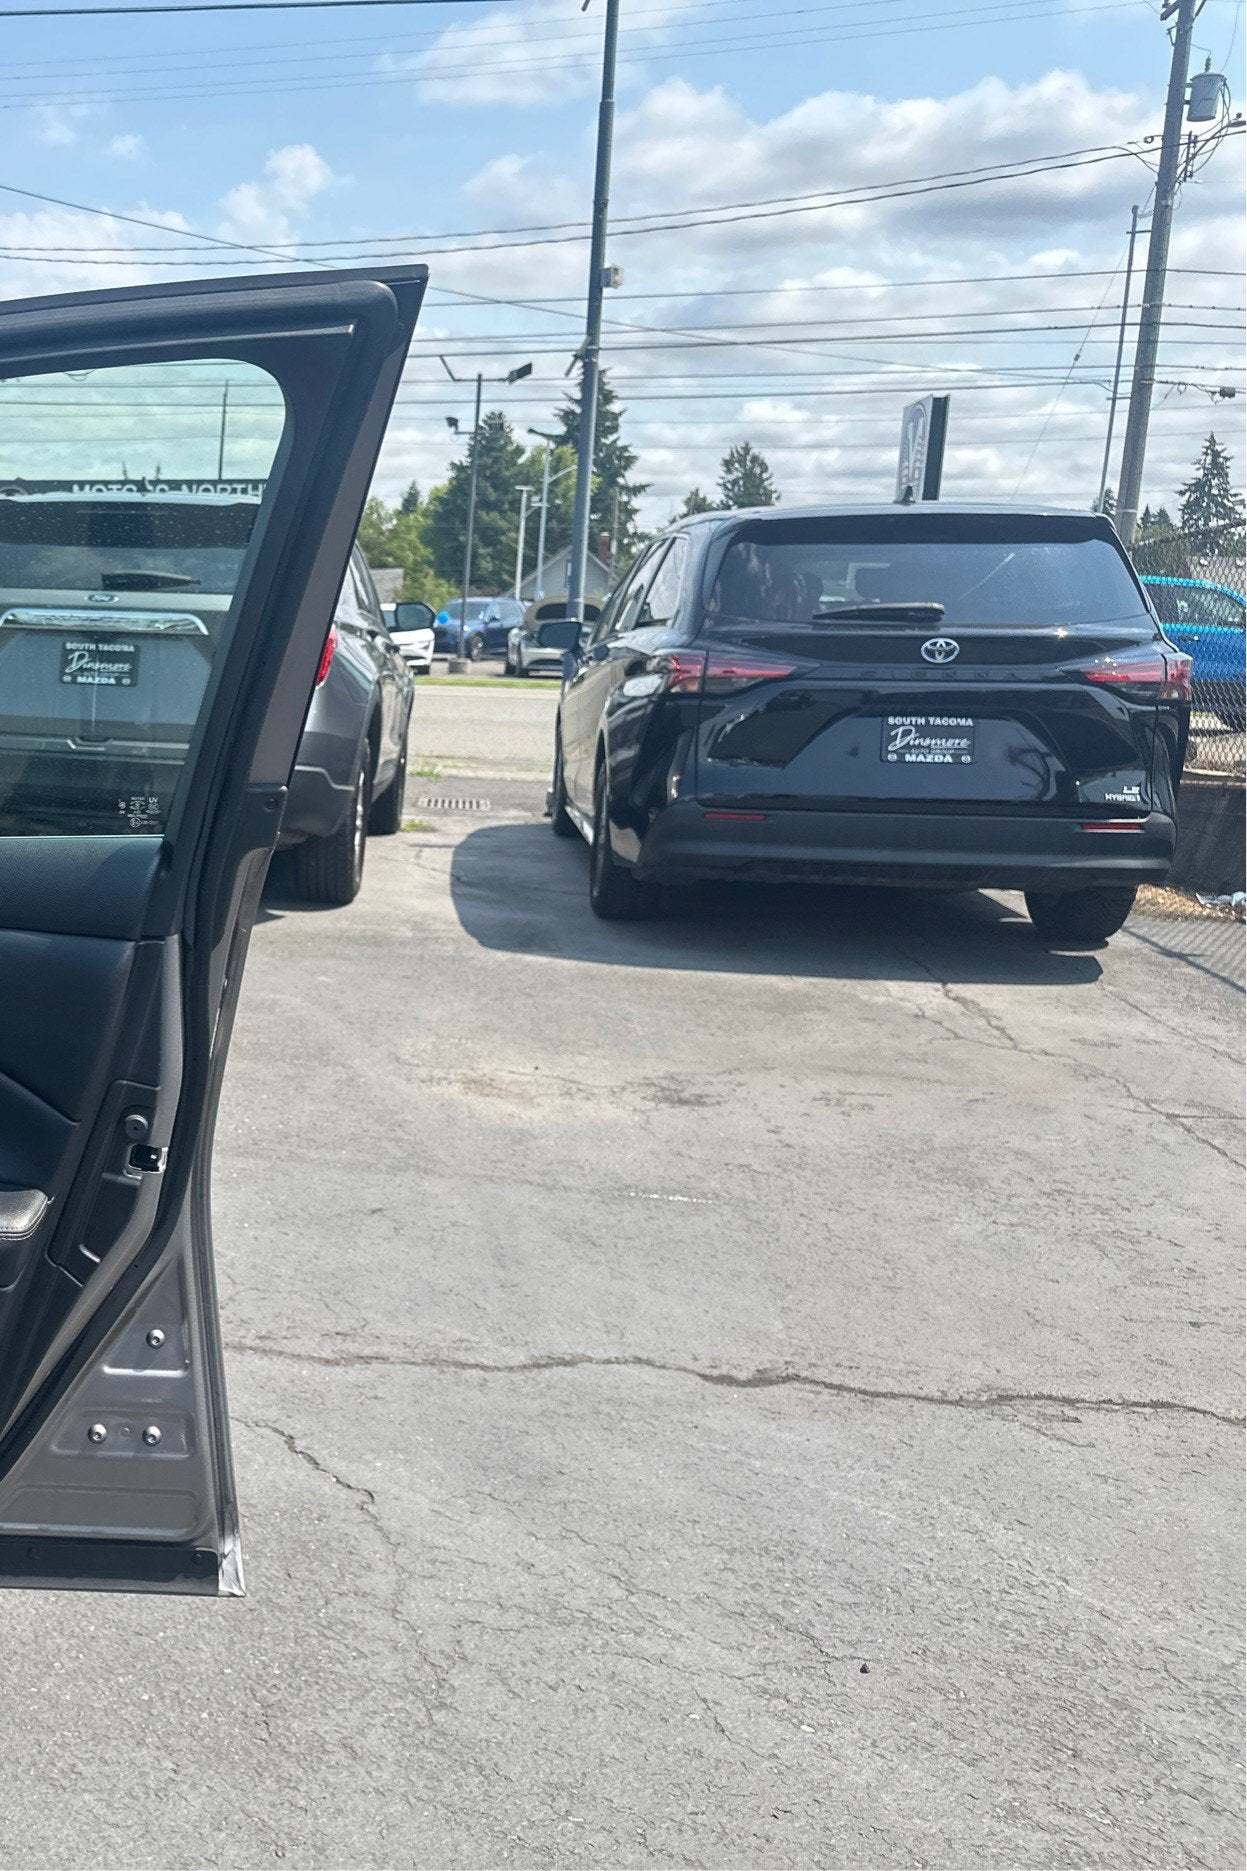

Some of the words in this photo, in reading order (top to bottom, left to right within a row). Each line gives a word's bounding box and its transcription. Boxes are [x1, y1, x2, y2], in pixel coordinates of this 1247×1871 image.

[181, 482, 267, 496] NORTH
[65, 642, 96, 650] SOUTH
[97, 643, 135, 652] TACOMA
[64, 650, 132, 673] Dinsmore
[76, 676, 116, 685] MAZDA
[887, 716, 926, 726] SOUTH
[928, 716, 974, 727] TACOMA
[887, 725, 971, 751] Dinsmore
[904, 753, 953, 763] MAZDA
